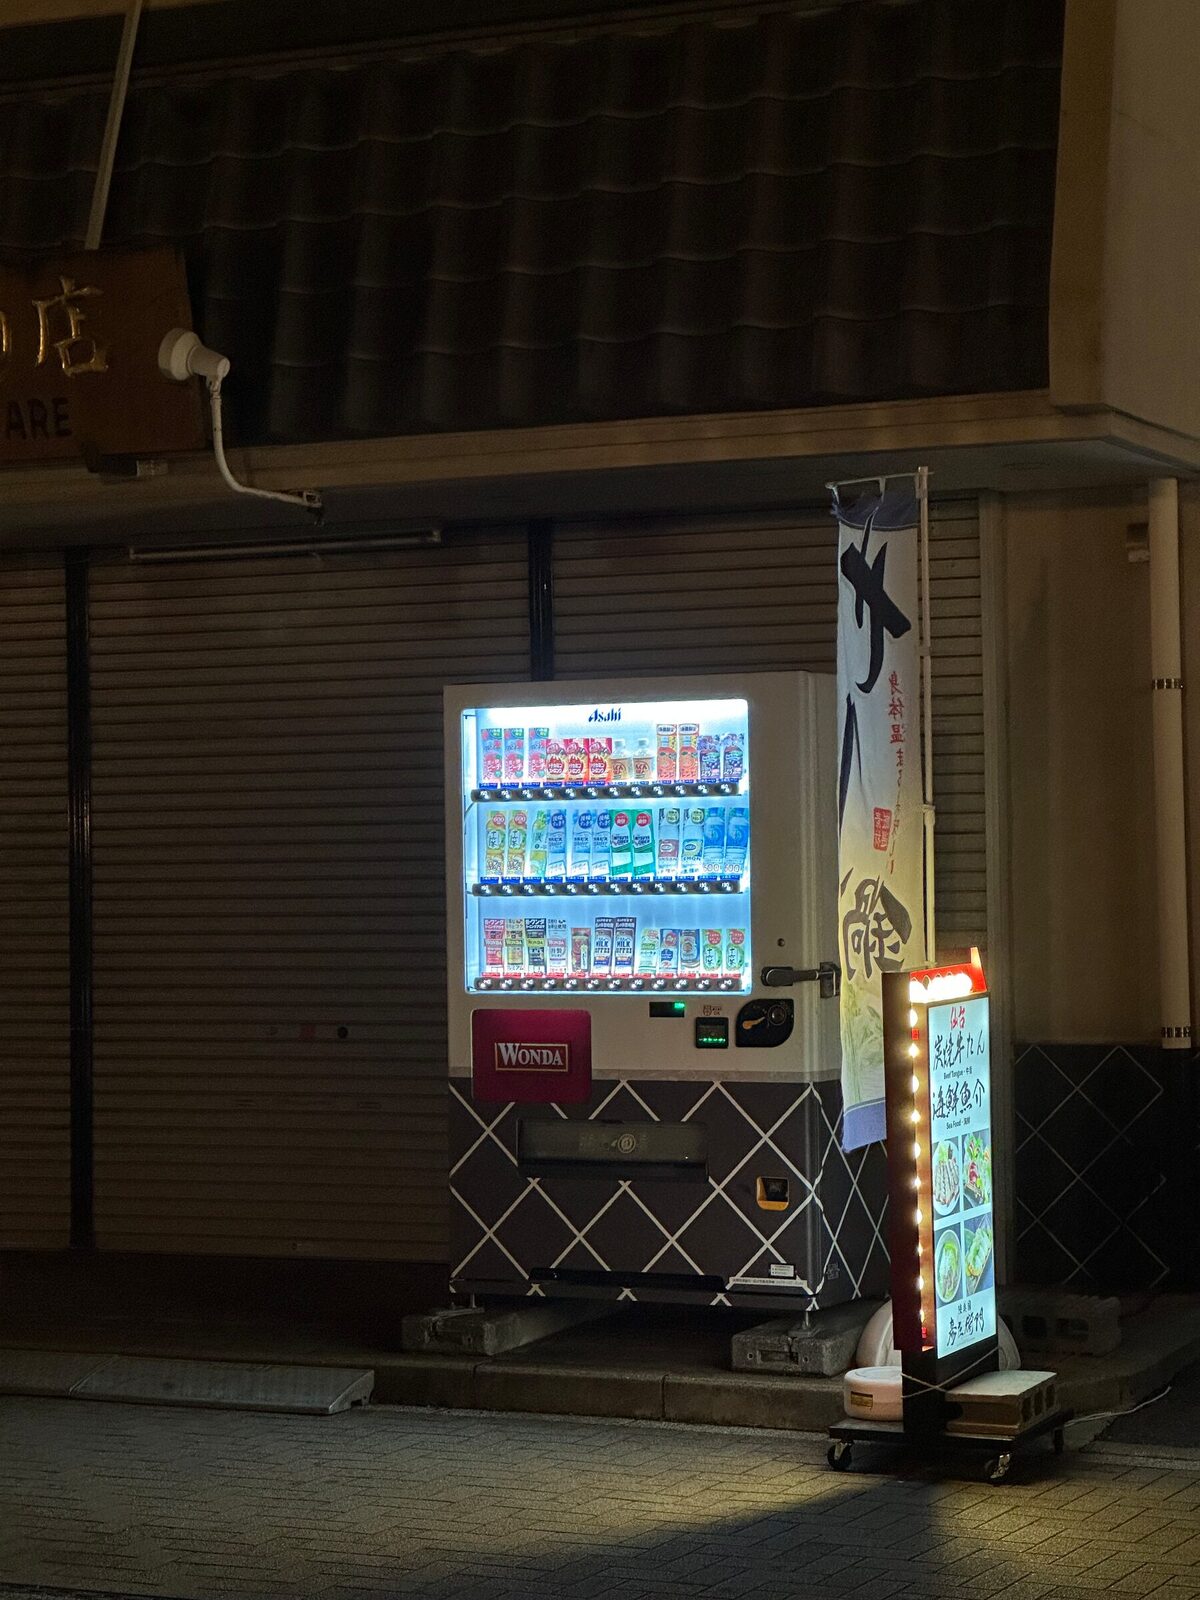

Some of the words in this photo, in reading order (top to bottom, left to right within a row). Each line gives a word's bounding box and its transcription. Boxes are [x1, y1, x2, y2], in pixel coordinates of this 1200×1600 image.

[0, 275, 108, 375] 店
[588, 707, 622, 723] Asahi
[497, 1042, 564, 1066] WONDA
